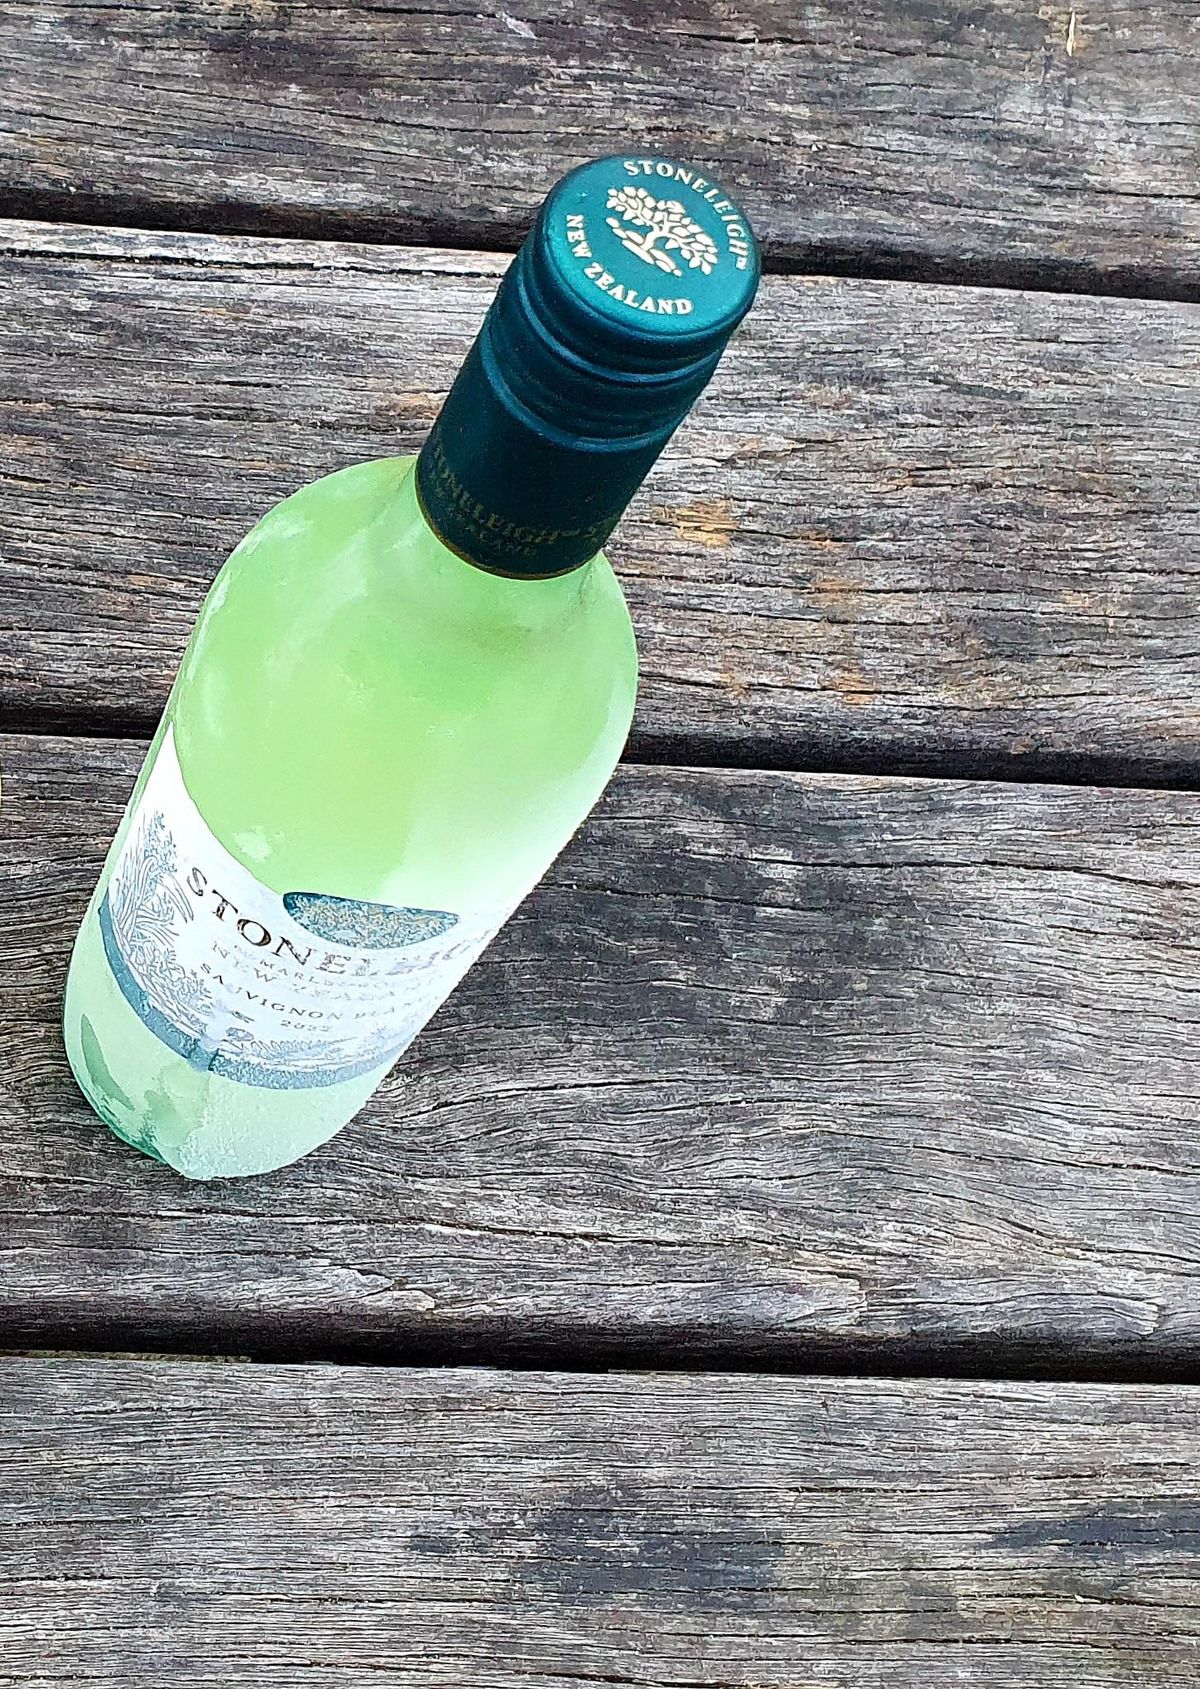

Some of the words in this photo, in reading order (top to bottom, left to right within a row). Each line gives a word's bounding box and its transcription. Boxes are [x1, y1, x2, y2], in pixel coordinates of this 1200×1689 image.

[566, 214, 592, 258] NEW
[583, 262, 695, 315] ZEALAND
[185, 866, 490, 975] STONEL
